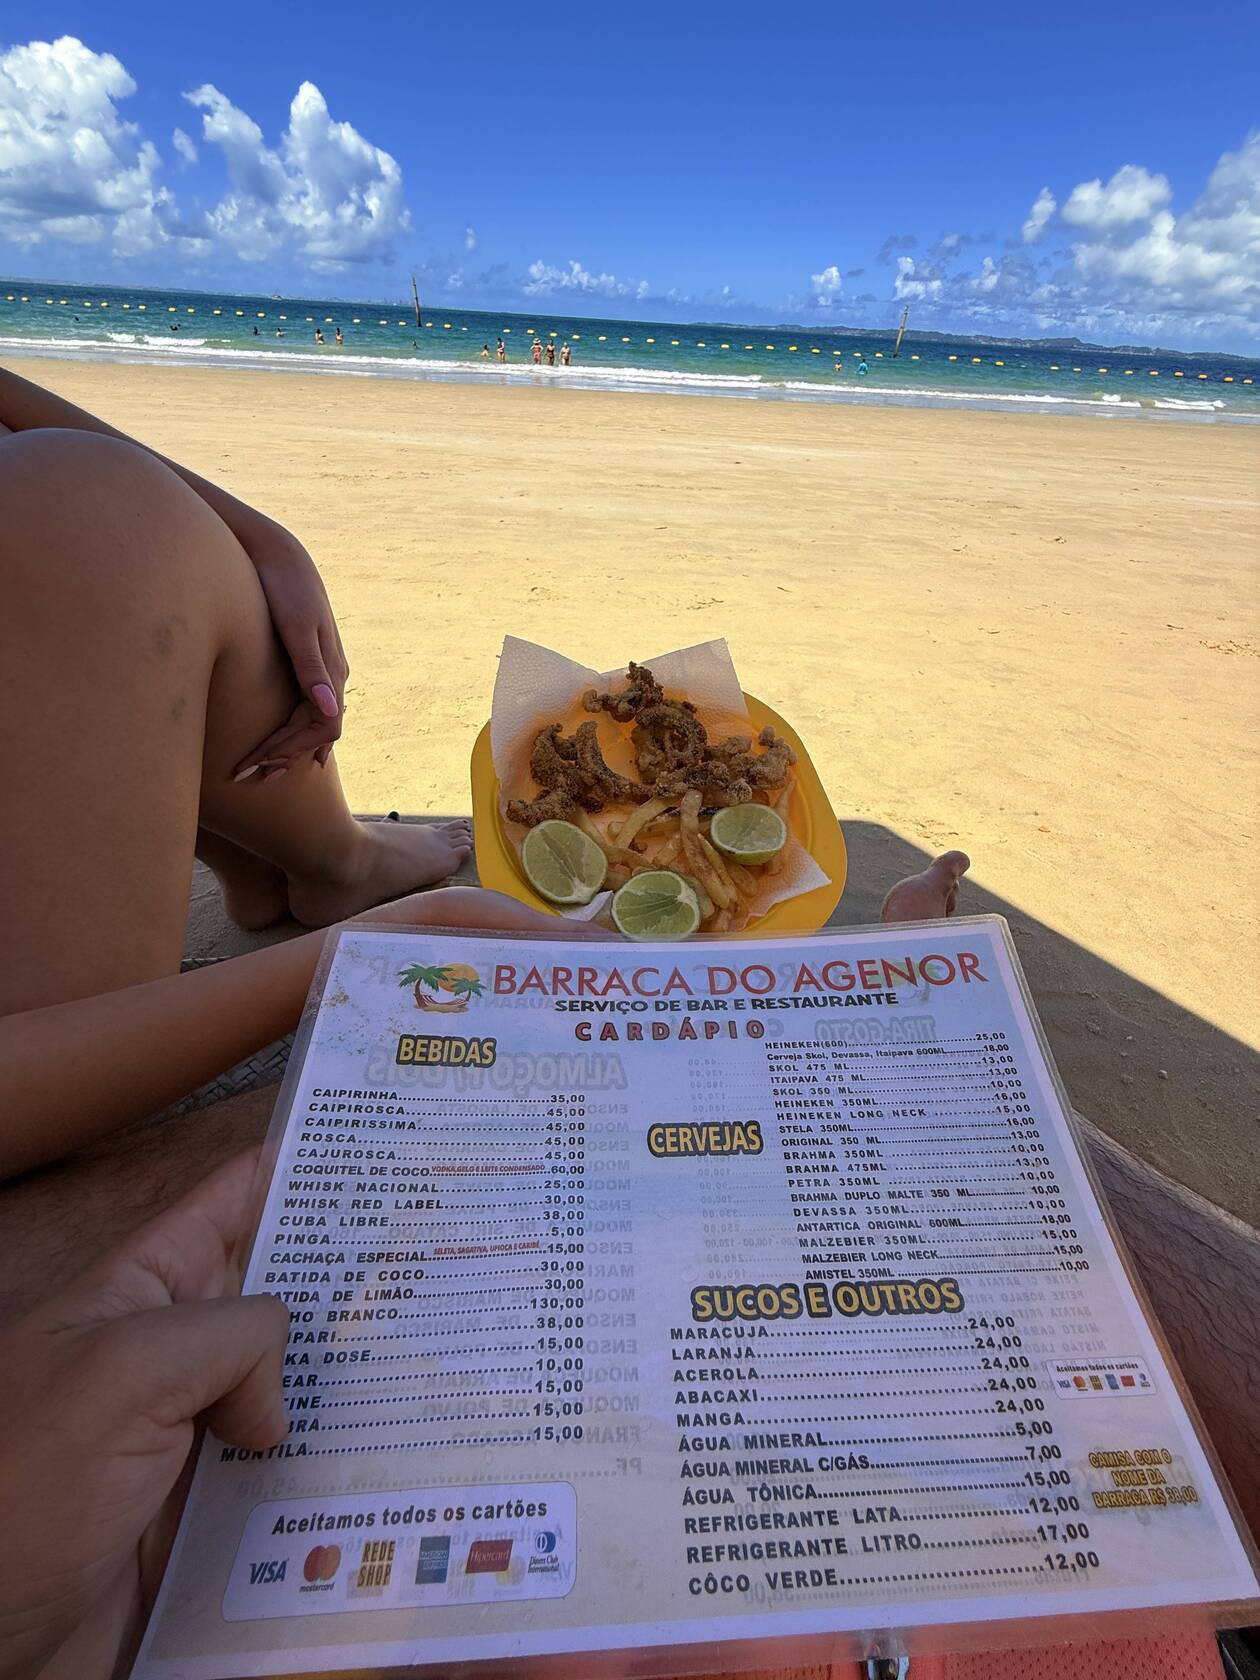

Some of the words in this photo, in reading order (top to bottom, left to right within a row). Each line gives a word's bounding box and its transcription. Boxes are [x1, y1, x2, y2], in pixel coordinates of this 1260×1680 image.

[493, 964, 694, 996] BARRACA
[708, 964, 776, 996] DO
[793, 952, 989, 993] AGENOR
[554, 1000, 649, 1015] SERVIÇO
[654, 1000, 682, 1012] DE
[687, 999, 729, 1011] BAR
[735, 998, 746, 1010] E
[752, 993, 899, 1009] RESTAURANTE
[575, 1017, 765, 1041] CARDÁPIO
[397, 1035, 496, 1067] BEBIDAS
[765, 1040, 849, 1050] HEINEKEN(600)
[975, 1032, 1005, 1042] 25,00
[767, 1053, 802, 1062] Cerveja
[805, 1052, 829, 1061] Skol,
[831, 1051, 874, 1060] Devassa,
[875, 1049, 913, 1058] Itaipava
[916, 1046, 947, 1056] 600ML
[983, 1043, 1009, 1053] 18,00
[768, 1064, 799, 1072] SKOL
[806, 1063, 827, 1071] 475
[981, 1055, 1013, 1065] 13,00
[312, 1088, 398, 1100] CAIPIRINHA
[550, 1095, 585, 1105] 35,00
[773, 1087, 803, 1096] SKOL
[810, 1087, 830, 1095] 350
[838, 1086, 854, 1094] ML
[990, 1079, 1022, 1089] 10,00
[777, 1111, 842, 1121] HEINEKEN
[850, 1110, 884, 1119] LONG
[893, 1108, 927, 1117] NECK
[995, 1104, 1031, 1114] 15,00
[305, 1117, 417, 1130] CAIPIRISSIMA
[546, 1122, 585, 1132] 45,00
[648, 1122, 762, 1155] CERVEJAS
[781, 1137, 833, 1147] ORIGINAL
[840, 1136, 859, 1145] 350
[866, 1135, 881, 1144] ML
[1010, 1130, 1040, 1140] 13,00
[296, 1148, 396, 1160] CAJUROSCA
[544, 1151, 585, 1161] 45,00
[783, 1150, 836, 1160] BRAHMA
[844, 1150, 883, 1158] 350ML
[1010, 1143, 1045, 1153] 10,00
[292, 1164, 365, 1176] COQUITEL
[369, 1166, 387, 1176] DE
[392, 1167, 430, 1177] COCO
[551, 1165, 585, 1176] 60,00
[481, 1165, 498, 1173] LEITE
[500, 1164, 546, 1172] CONDENSADO
[788, 1178, 831, 1188] PETRA
[839, 1177, 881, 1187] 350ML
[1019, 1171, 1055, 1181] 10,00
[283, 1198, 340, 1209] WHISK
[351, 1199, 383, 1209] RED
[394, 1200, 444, 1210] LABEL
[544, 1195, 584, 1206] 30,00
[790, 1193, 838, 1202] BRAHMA
[844, 1191, 881, 1201] DUPLO
[888, 1190, 924, 1199] MALTE
[930, 1188, 950, 1198] 350
[956, 1188, 973, 1197] ML
[1031, 1185, 1060, 1195] 10,00
[279, 1215, 327, 1227] CUBA
[339, 1216, 390, 1227] LIBRE
[543, 1210, 584, 1222] 38,00
[796, 1222, 861, 1232] ANTARTICA
[868, 1220, 922, 1230] ORIGINAL
[929, 1218, 965, 1228] 600ML
[1041, 1214, 1071, 1225] 18,00
[274, 1234, 330, 1245] PINGA
[551, 1226, 584, 1238] 5,00
[269, 1252, 346, 1266] CACHAÇA
[356, 1251, 428, 1263] ESPECIAL
[547, 1243, 584, 1255] 15,00
[802, 1253, 867, 1264] MALZEBIER
[871, 1251, 903, 1261] LONG
[908, 1250, 940, 1260] NECK
[1053, 1244, 1083, 1255] 15,00
[264, 1271, 331, 1283] BATIDA
[343, 1271, 366, 1282] DE
[378, 1269, 425, 1281] COCO
[540, 1261, 584, 1273] 30,00
[805, 1269, 855, 1280] AMISTEL
[858, 1268, 895, 1278] 350ML
[1060, 1260, 1089, 1272] 10,00
[332, 1290, 354, 1302] DE
[364, 1287, 414, 1301] LIMÃO
[544, 1279, 584, 1291] 30,00
[692, 1286, 801, 1319] SUCOS
[806, 1284, 830, 1316] E
[835, 1280, 962, 1315] OUTROS
[327, 1309, 398, 1322] BRANCO
[530, 1298, 584, 1311] 130,00
[536, 1317, 584, 1331] 38,00
[670, 1325, 769, 1340] MARACUJA
[968, 1317, 1015, 1331] 24,00
[323, 1350, 371, 1364] DOSE
[537, 1337, 584, 1351] 15,00
[671, 1346, 756, 1361] LARANJA
[975, 1336, 1022, 1350] 24,00
[535, 1358, 584, 1373] 10,00
[673, 1367, 759, 1382] ACEROLA
[981, 1355, 1030, 1372] 24,00
[534, 1380, 584, 1395] 15,00
[674, 1389, 758, 1405] ABACAXI
[988, 1376, 1037, 1392] 24,00
[533, 1403, 584, 1418] 15,00
[676, 1412, 746, 1428] MANGA
[995, 1398, 1045, 1415] 24,00
[220, 1443, 308, 1463] MONTILA
[533, 1426, 583, 1442] 15,00
[678, 1434, 731, 1451] ÁGUA
[744, 1432, 827, 1450] MINERAL
[1016, 1420, 1053, 1437] 5,00
[680, 1460, 730, 1478] ÁGUA
[735, 1457, 814, 1477] MINERAL
[818, 1452, 870, 1472] C/GÁS
[1026, 1445, 1062, 1463] 7,00
[1088, 1451, 1133, 1468] CAMISA
[1136, 1449, 1161, 1465] COM
[1162, 1448, 1172, 1464] O
[682, 1486, 734, 1506] ÁGUA
[747, 1482, 817, 1502] TÔNICA
[1024, 1469, 1071, 1488] 15,00
[1111, 1470, 1145, 1487] NOME
[1148, 1468, 1166, 1484] DA
[1092, 1489, 1149, 1509] BARRACA
[1151, 1488, 1166, 1505] R$
[272, 1512, 375, 1535] Aceitamos
[382, 1505, 436, 1524] todos
[444, 1505, 464, 1521] os
[471, 1499, 548, 1519] cartões
[684, 1510, 840, 1534] REFRIGERANTE
[852, 1506, 902, 1524] LATA
[1028, 1496, 1080, 1515] 12,00
[362, 1540, 396, 1563] REDE
[686, 1537, 848, 1564] REFRIGERANTE
[861, 1533, 922, 1553] LITRO
[1037, 1523, 1090, 1543] 17,00
[249, 1559, 289, 1585] VISA
[357, 1565, 392, 1588] SHOP
[688, 1572, 751, 1595] CÔCO
[765, 1568, 838, 1590] VERDE
[1044, 1551, 1100, 1573] 12,00
